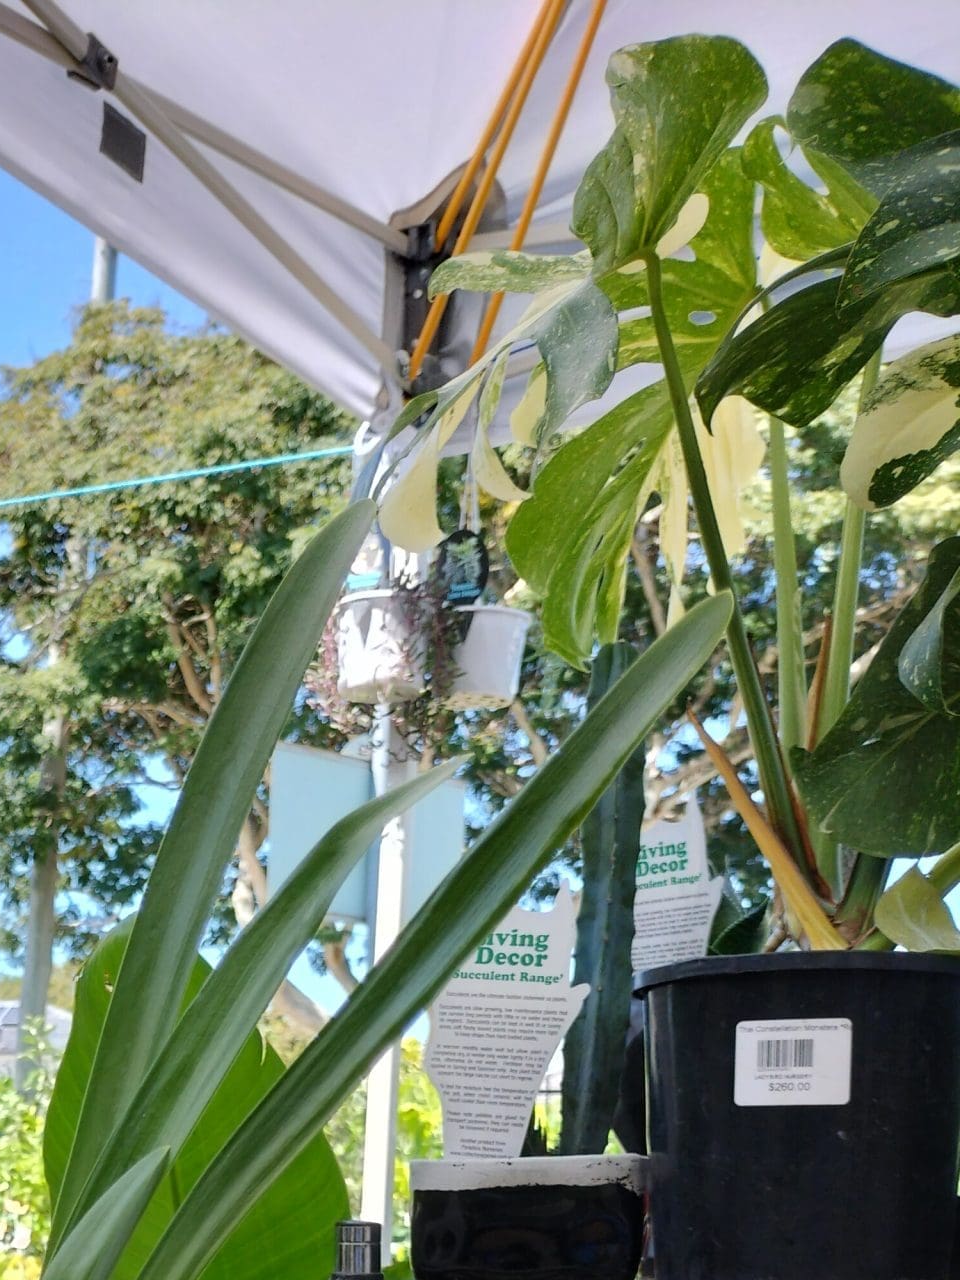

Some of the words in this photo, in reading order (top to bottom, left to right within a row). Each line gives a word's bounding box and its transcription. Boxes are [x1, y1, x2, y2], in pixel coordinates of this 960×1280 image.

[637, 842, 688, 860] iving
[635, 859, 688, 877] Decor
[480, 928, 550, 953] iving
[474, 946, 548, 968] Decor
